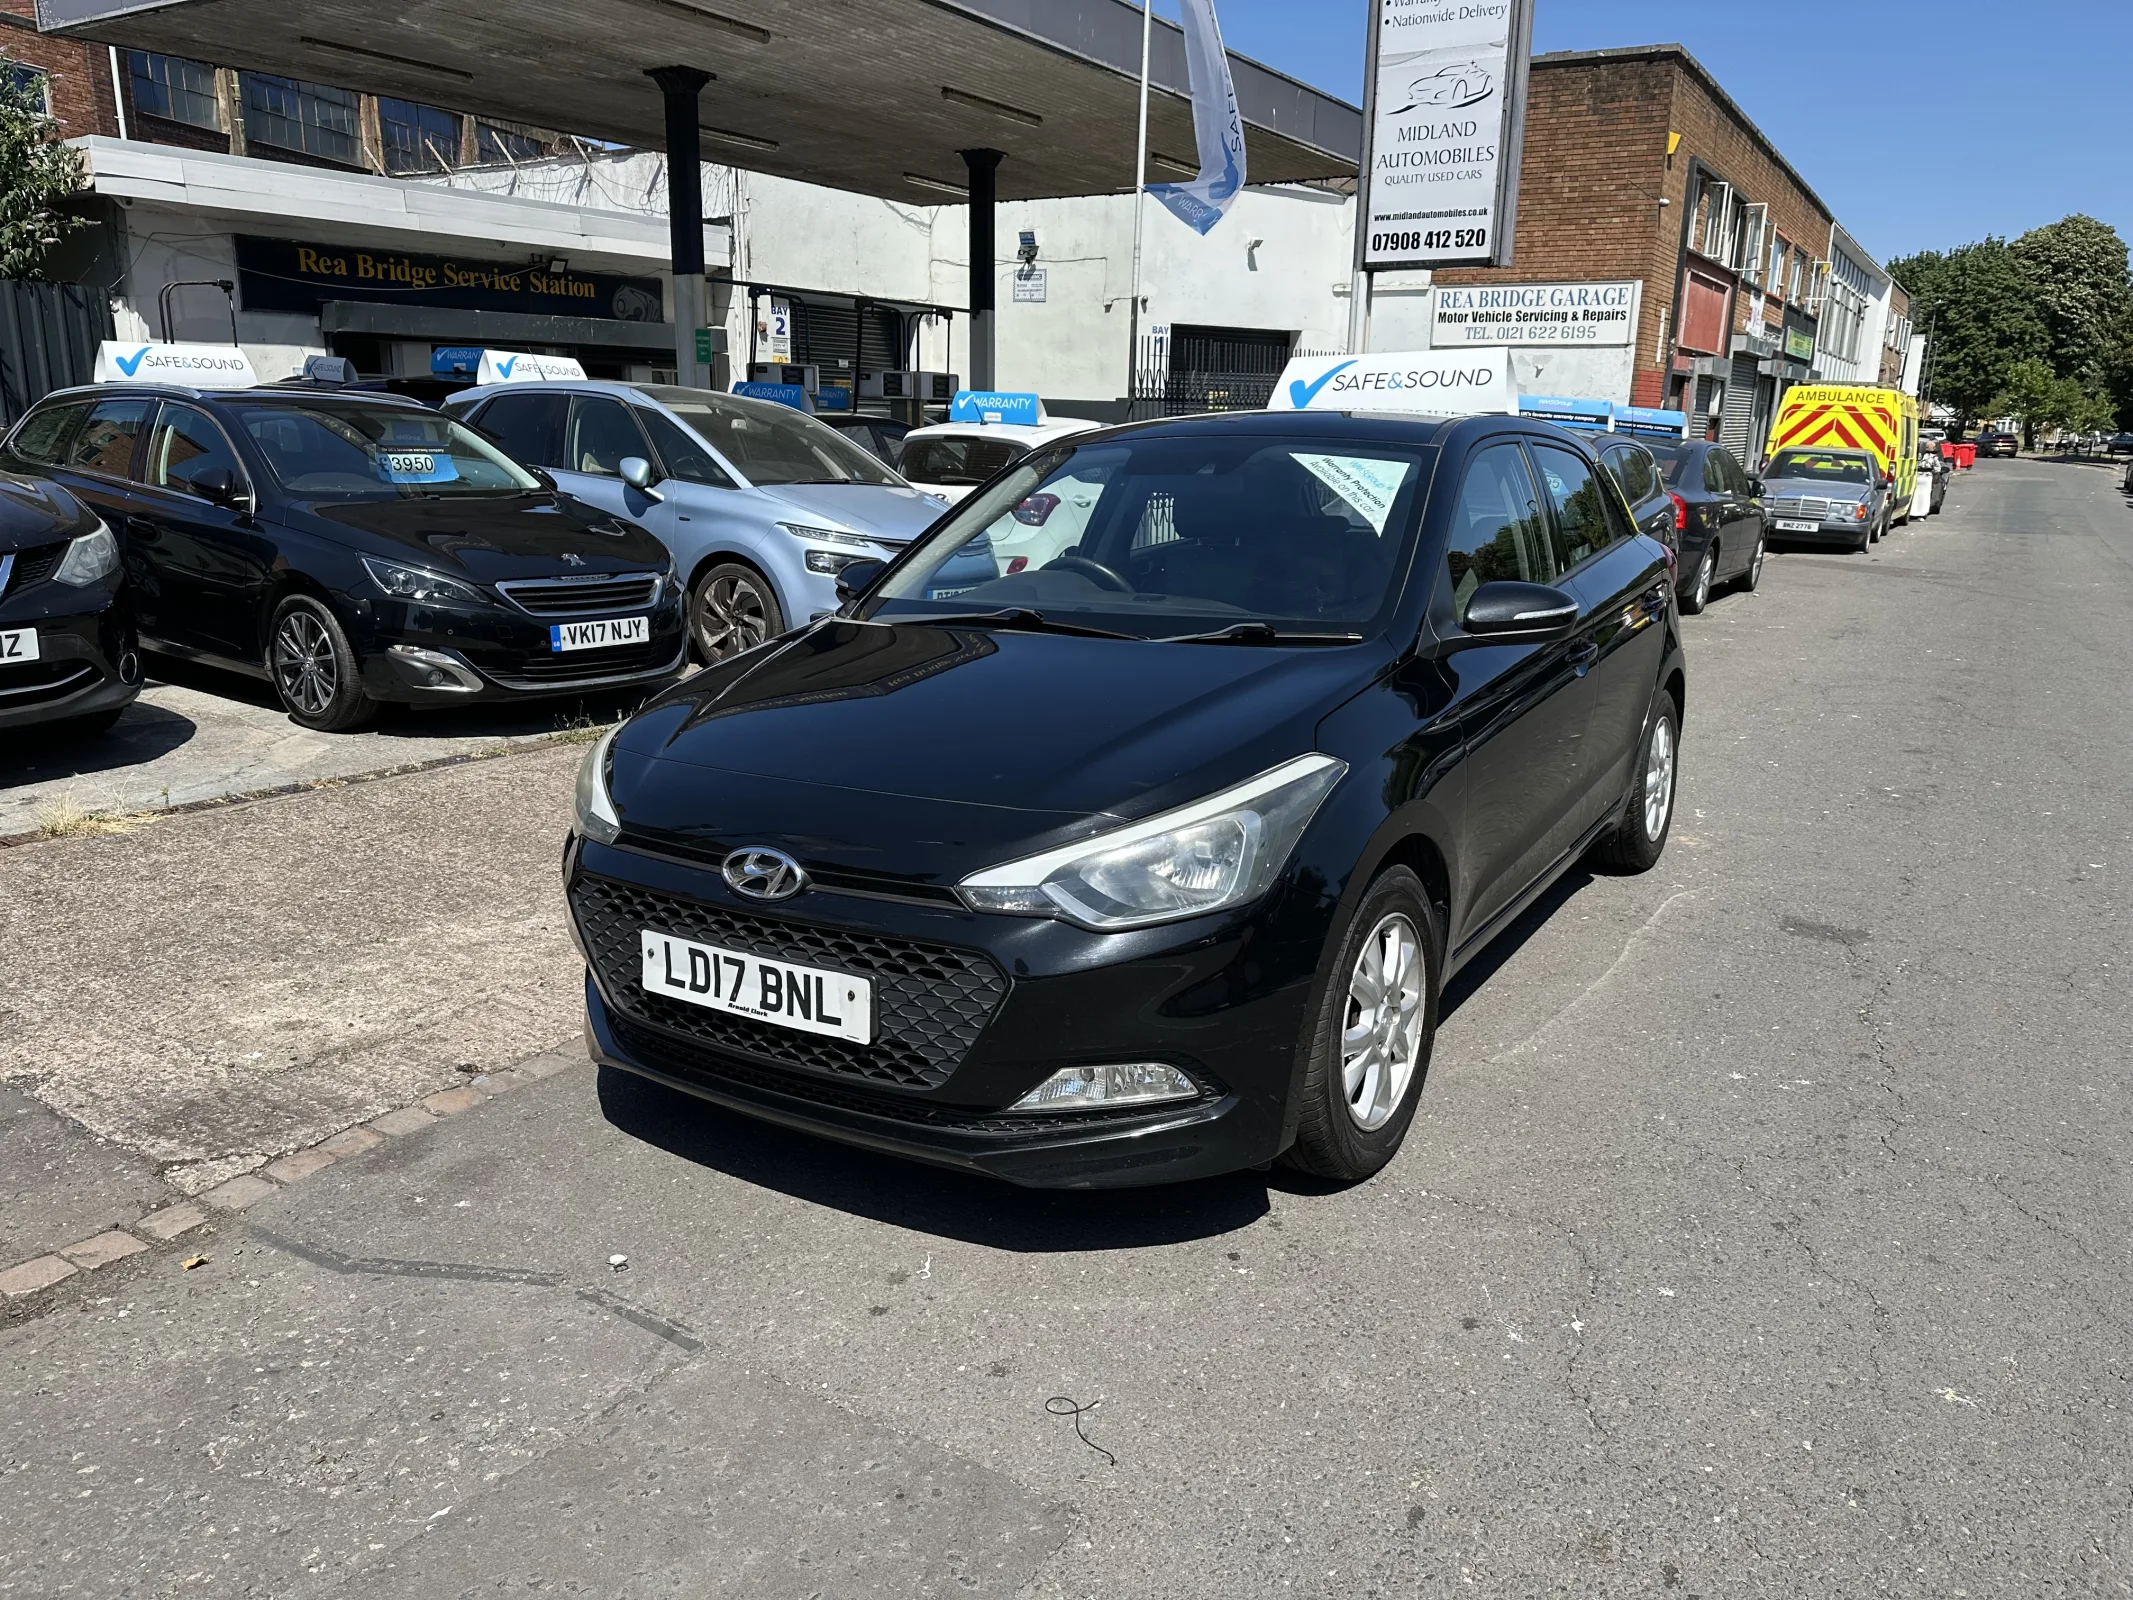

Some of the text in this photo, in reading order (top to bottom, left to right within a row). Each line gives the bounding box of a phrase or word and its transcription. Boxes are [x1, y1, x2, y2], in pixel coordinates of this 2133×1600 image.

[1392, 3, 1507, 28] Nationwide Delivery
[1397, 120, 1477, 143] MIDLAND
[1376, 145, 1495, 169] AUTOMOBILES
[1384, 169, 1483, 187] QUALITY USED CARS
[1373, 207, 1488, 222] www.midlandautomobiles.co.uk
[1372, 228, 1486, 252] 07908 412 520
[297, 247, 596, 298] Rea Bridge Service Station
[1439, 287, 1629, 309] REA BRIDGE GARAGE
[771, 306, 789, 316] BAY
[1438, 309, 1627, 323] Motor Vehicle Servicing & Repairs
[775, 316, 786, 336] 2
[1152, 325, 1169, 335] BAY
[1465, 325, 1597, 340] TEL. 0121 622 6195
[145, 355, 244, 371] SAFE&SOUND
[447, 349, 482, 360] WARRANT
[515, 362, 581, 377] SAFE&SOUND
[1332, 368, 1493, 392] SAFE&SOUND
[748, 386, 798, 399] WARRANTY
[1796, 390, 1886, 404] AMBULANCE
[973, 396, 1032, 410] WARRANTY
[1309, 461, 1375, 513] Available on this car
[1321, 457, 1386, 509] Warranty Protection
[566, 619, 642, 645] VK17 NJY
[0, 633, 22, 658] Z
[663, 941, 842, 1027] LD17 BNL
[727, 1002, 750, 1013] Arnold
